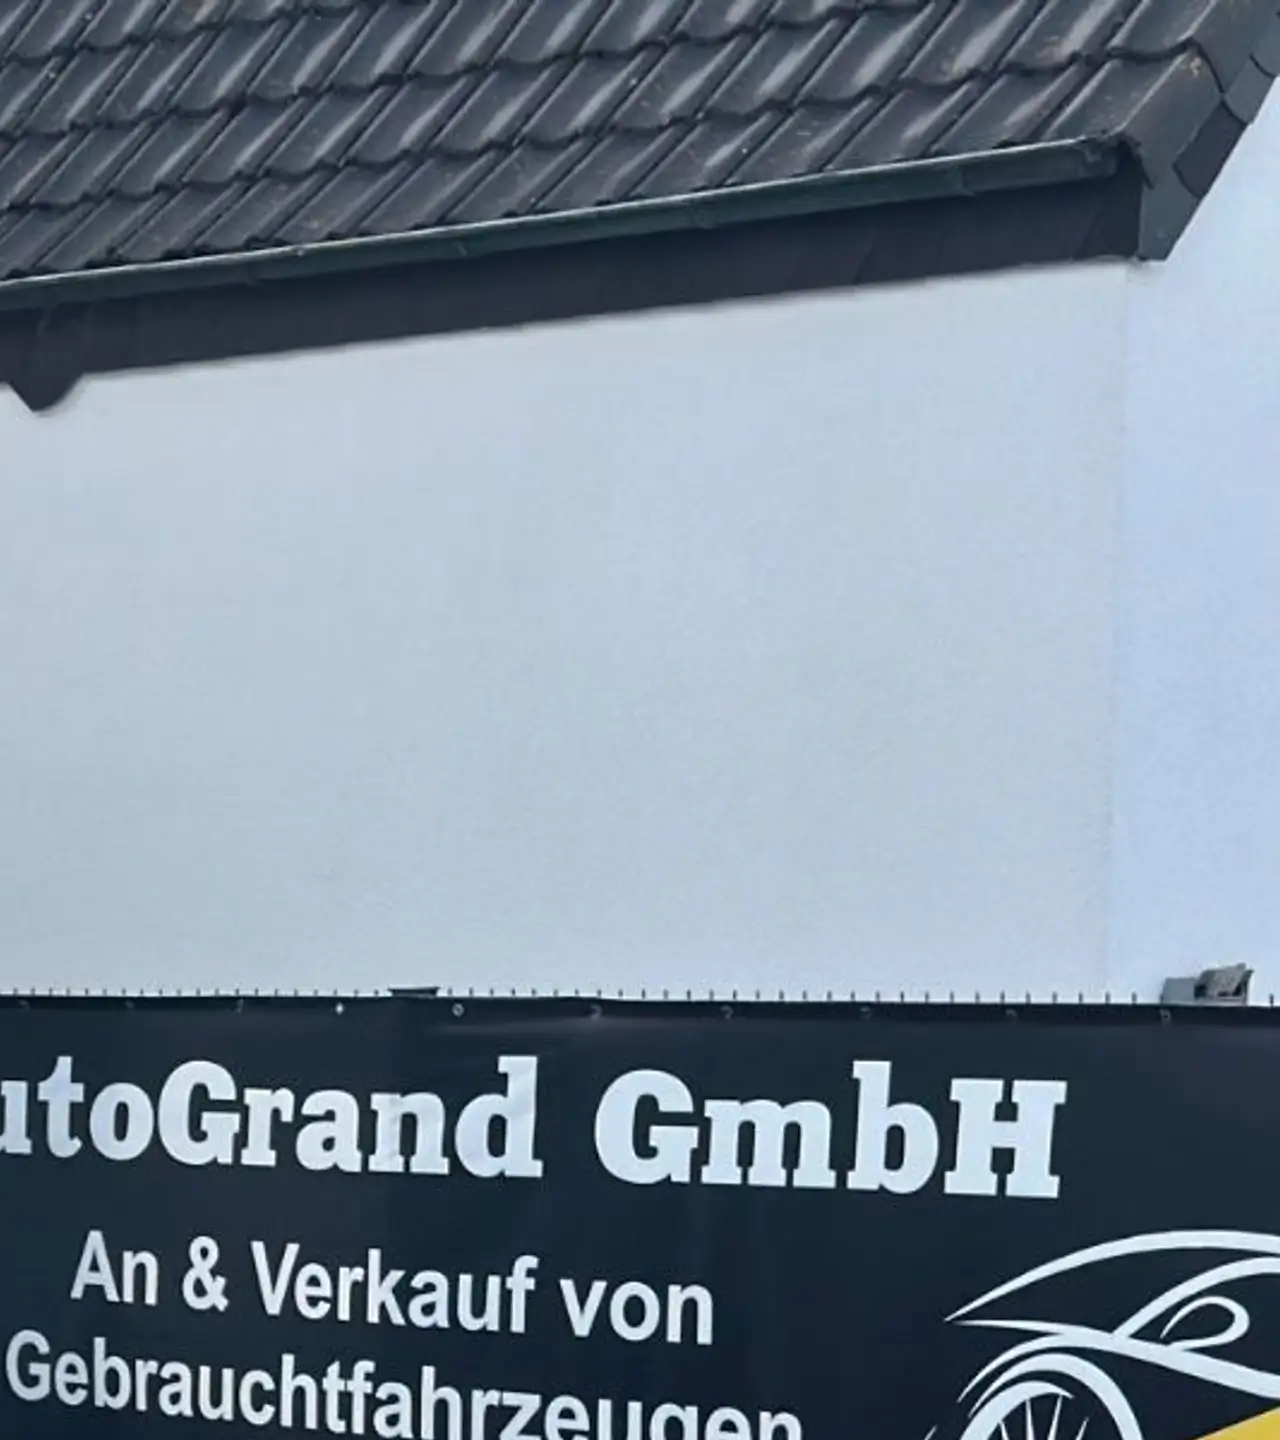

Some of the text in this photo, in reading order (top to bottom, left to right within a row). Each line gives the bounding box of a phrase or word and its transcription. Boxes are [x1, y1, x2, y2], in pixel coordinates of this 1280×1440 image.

[594, 1059, 1068, 1199] GmbH
[70, 1229, 714, 1345] An & Verkauf von
